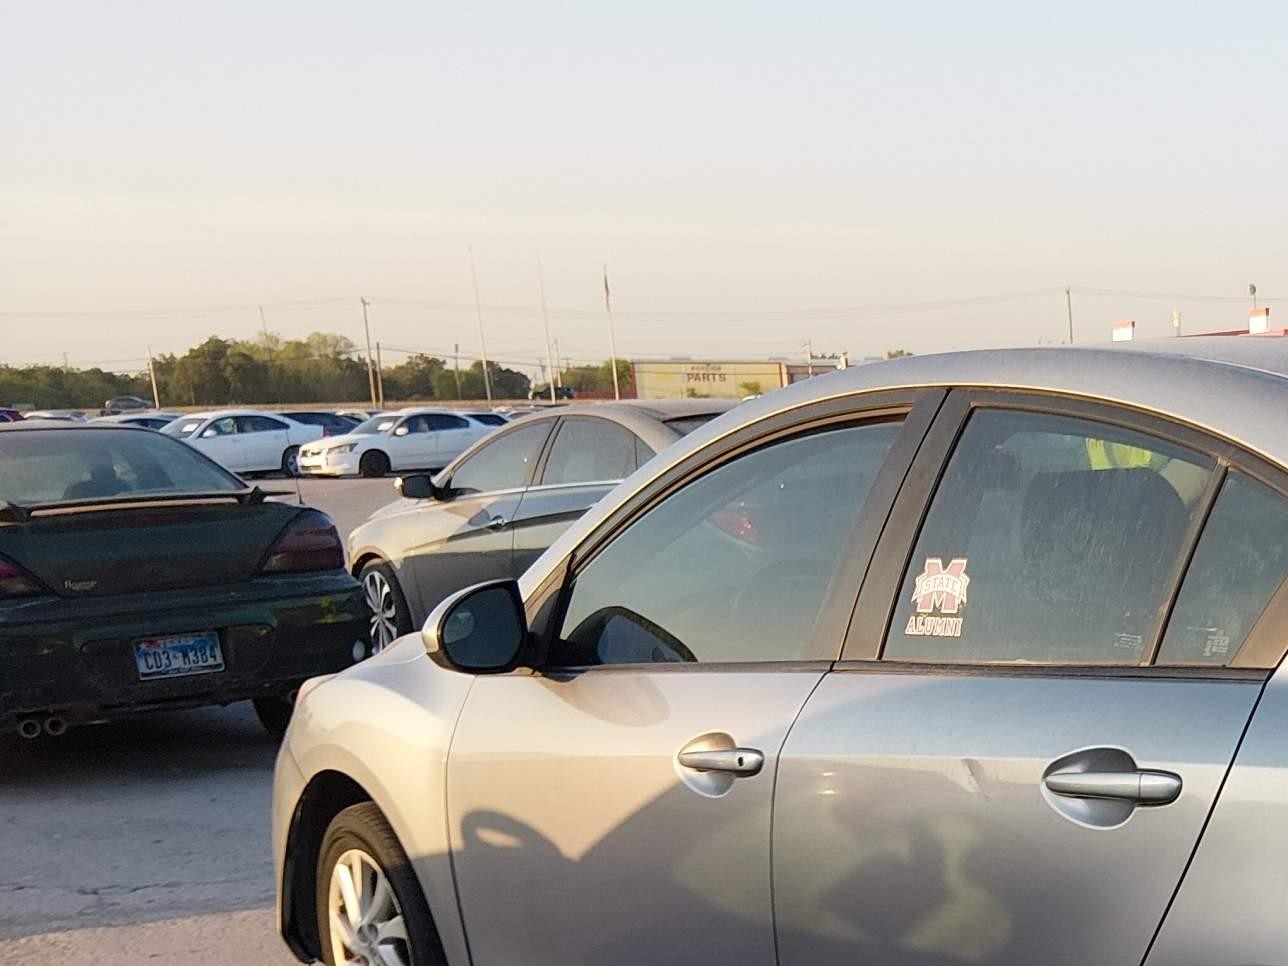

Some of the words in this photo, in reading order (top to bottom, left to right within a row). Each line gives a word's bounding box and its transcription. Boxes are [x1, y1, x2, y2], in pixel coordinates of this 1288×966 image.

[686, 372, 727, 382] PARTS
[923, 576, 961, 596] STATE
[904, 615, 963, 637] ALUMNI
